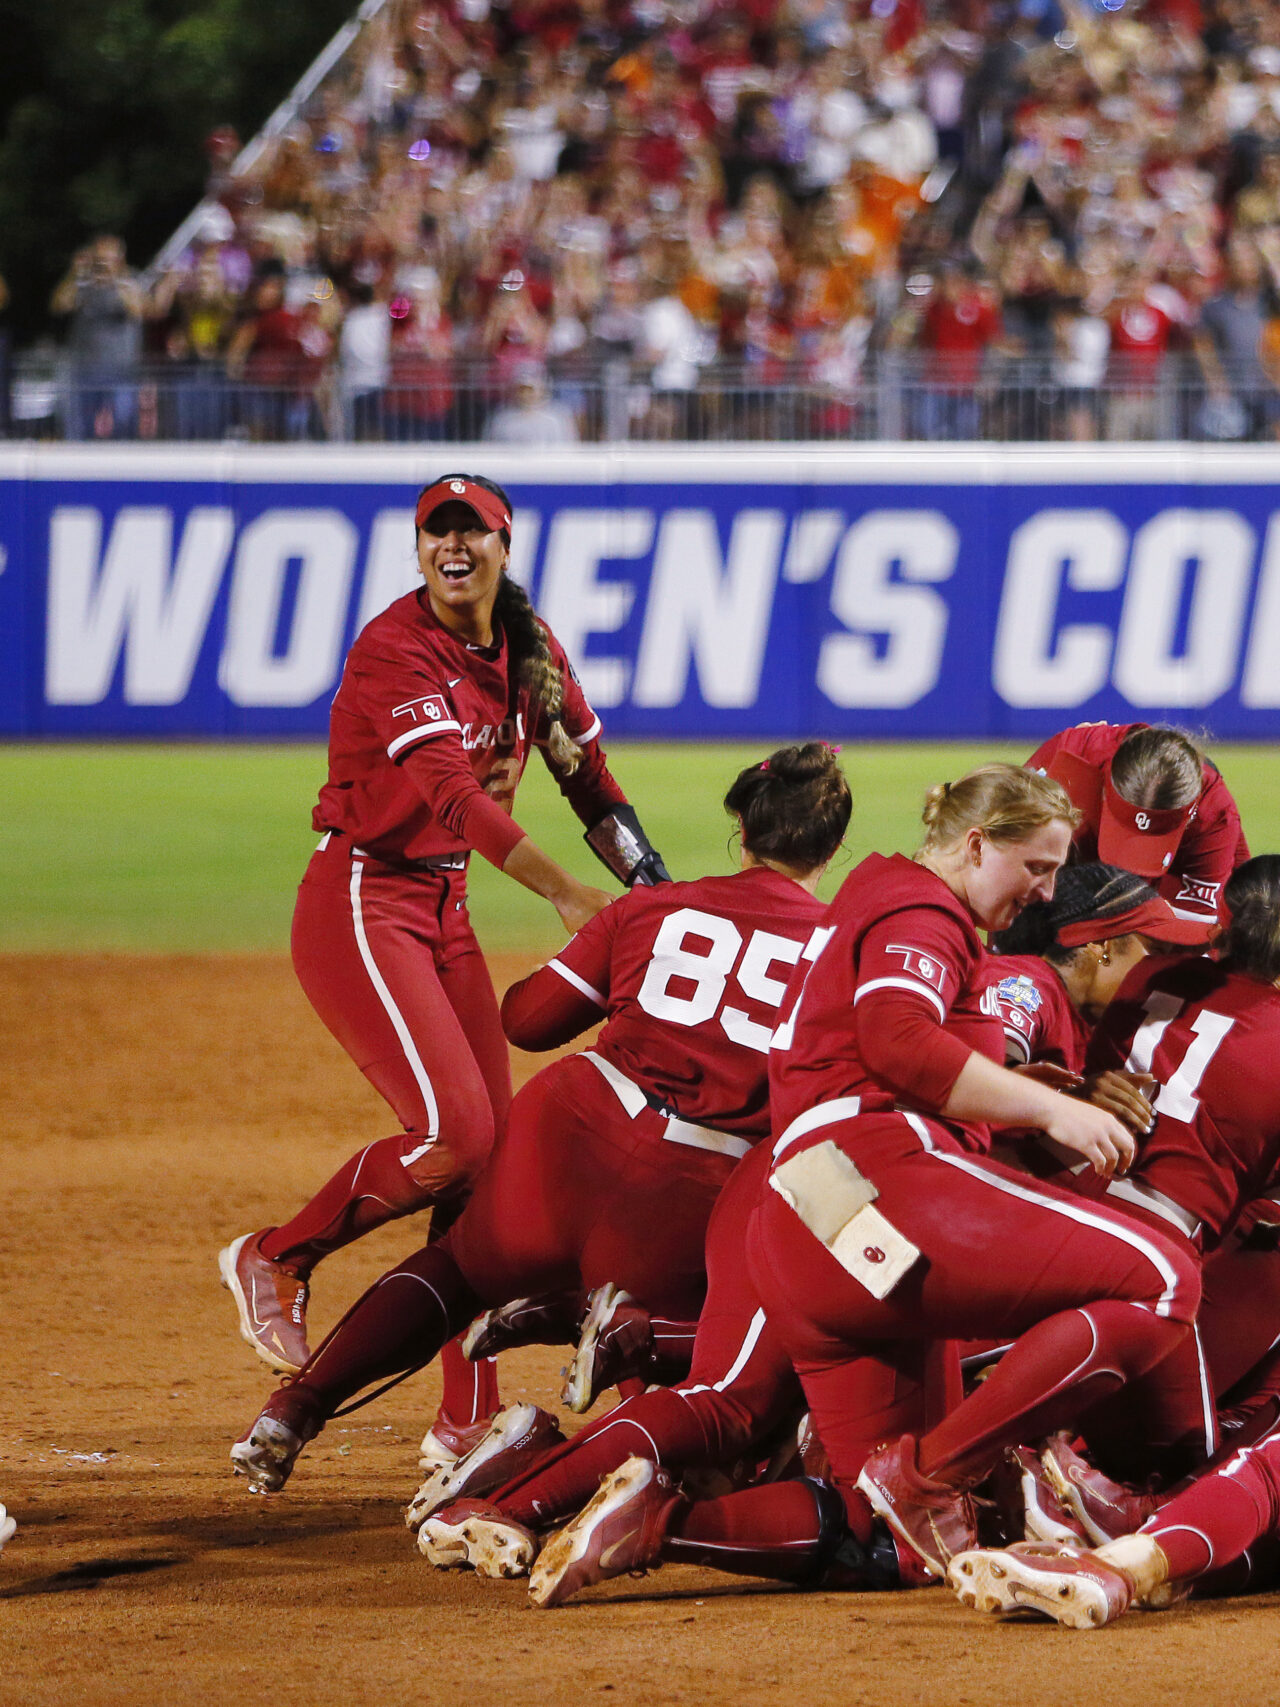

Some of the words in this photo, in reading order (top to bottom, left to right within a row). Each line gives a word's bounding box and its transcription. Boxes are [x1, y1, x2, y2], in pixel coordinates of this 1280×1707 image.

[449, 481, 467, 495] OU
[423, 701, 442, 720] OU
[1134, 812, 1151, 830] OU
[918, 957, 935, 979] OU
[637, 908, 805, 1055] 85
[1125, 989, 1236, 1124] 11
